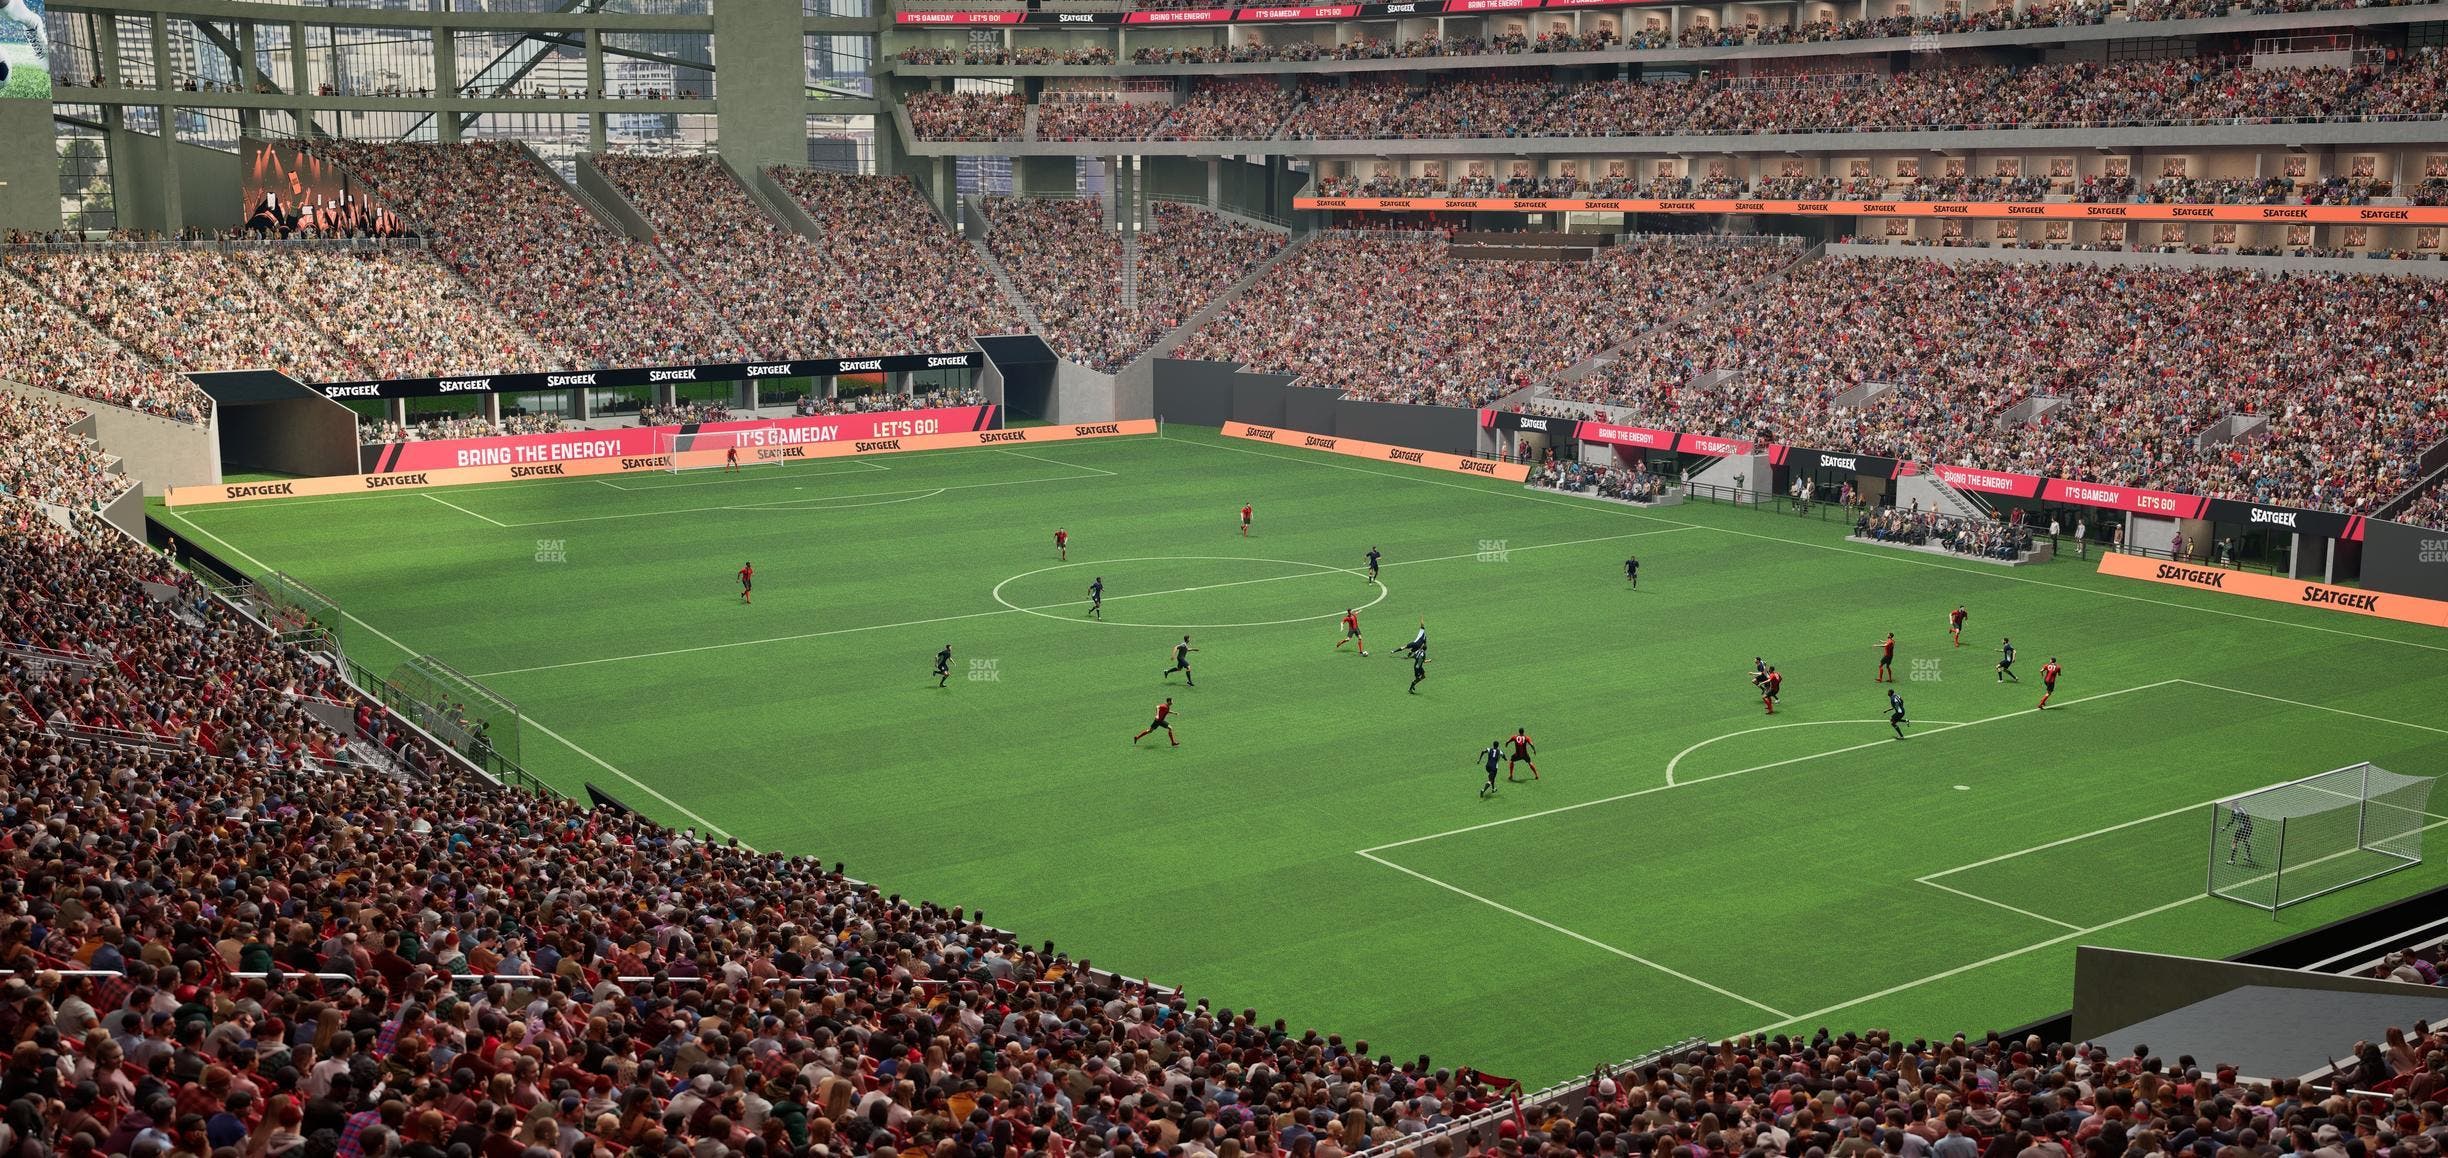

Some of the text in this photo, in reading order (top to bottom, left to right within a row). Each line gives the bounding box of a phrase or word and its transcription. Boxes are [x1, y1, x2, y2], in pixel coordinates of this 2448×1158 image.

[1388, 4, 1414, 13] SEATGEEK
[1060, 14, 1093, 22] SEATGEEK
[1864, 204, 1896, 212] SEATGEEK
[2008, 206, 2044, 214] SEATGEEK
[2088, 207, 2126, 215] SEATGEEK
[2172, 208, 2214, 216] SEATGEEK
[2263, 209, 2308, 218] SEATGEEK
[2361, 210, 2408, 219] SEATGEEK
[840, 360, 881, 372] SEATGEEK
[928, 356, 968, 368] SEATGEEK
[649, 369, 696, 381] SEATGEEK
[747, 364, 791, 376] SEATGEEK
[440, 379, 491, 392] SEATGEEK
[547, 374, 596, 387] SEATGEEK
[326, 384, 380, 397] SEATGEEK
[873, 418, 939, 437] LET'S GO!
[1075, 424, 1120, 436] SEATGEEK
[1520, 417, 1548, 431] SEATGEEK
[736, 426, 839, 447] IT'S GAMEDAY
[980, 431, 1027, 443] SEATGEEK
[1246, 427, 1275, 440] SEATGEEK
[1599, 428, 1654, 444] BRING THE ENERGY!
[855, 440, 901, 452] SEATGEEK
[1305, 436, 1337, 450] SEATGEEK
[1695, 440, 1707, 450] IT'S
[457, 440, 621, 467] BRING THE ENERGY!
[1389, 448, 1424, 463] SEATGEEK
[622, 456, 673, 470] SEATGEEK
[1459, 459, 1497, 474] SEATGEEK
[1821, 454, 1856, 471] SEATGEEK
[510, 463, 564, 477] SEATGEEK
[366, 473, 429, 488] SEATGEEK
[1967, 474, 1981, 486] THE
[1982, 476, 2012, 490] ENERGY!
[226, 482, 294, 499] SEATGEEK
[2065, 486, 2119, 504] IT'S GAMEDAY
[2138, 495, 2176, 510] LET'S GO!
[2251, 508, 2297, 528] SEATGEEK
[2156, 564, 2226, 588] SEATGEEK
[2302, 586, 2379, 612] SEATGEEK
